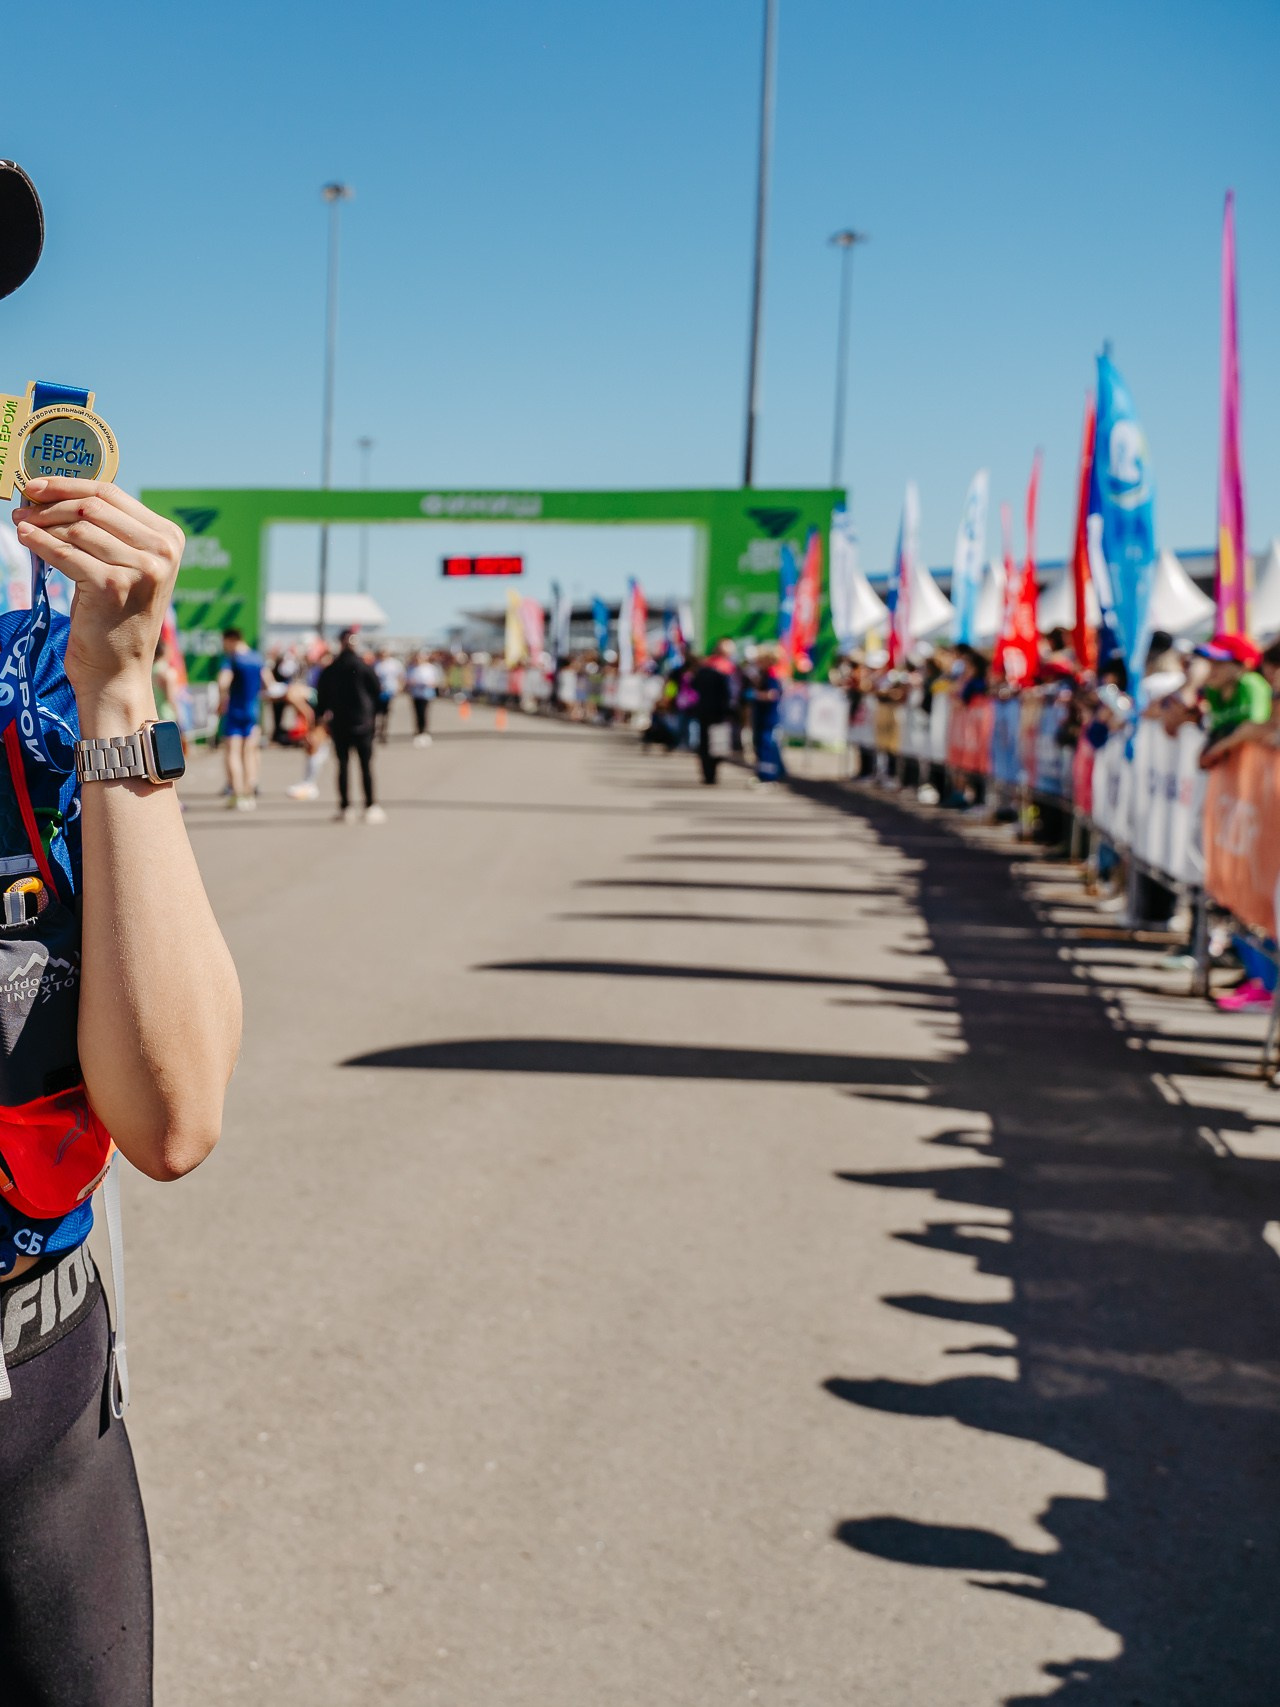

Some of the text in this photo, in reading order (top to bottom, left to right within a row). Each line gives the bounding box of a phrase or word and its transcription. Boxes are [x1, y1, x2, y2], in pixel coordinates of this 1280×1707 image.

[31, 445, 95, 467] ГЕРОЙ!
[39, 465, 81, 479] 10 ЛЕТ
